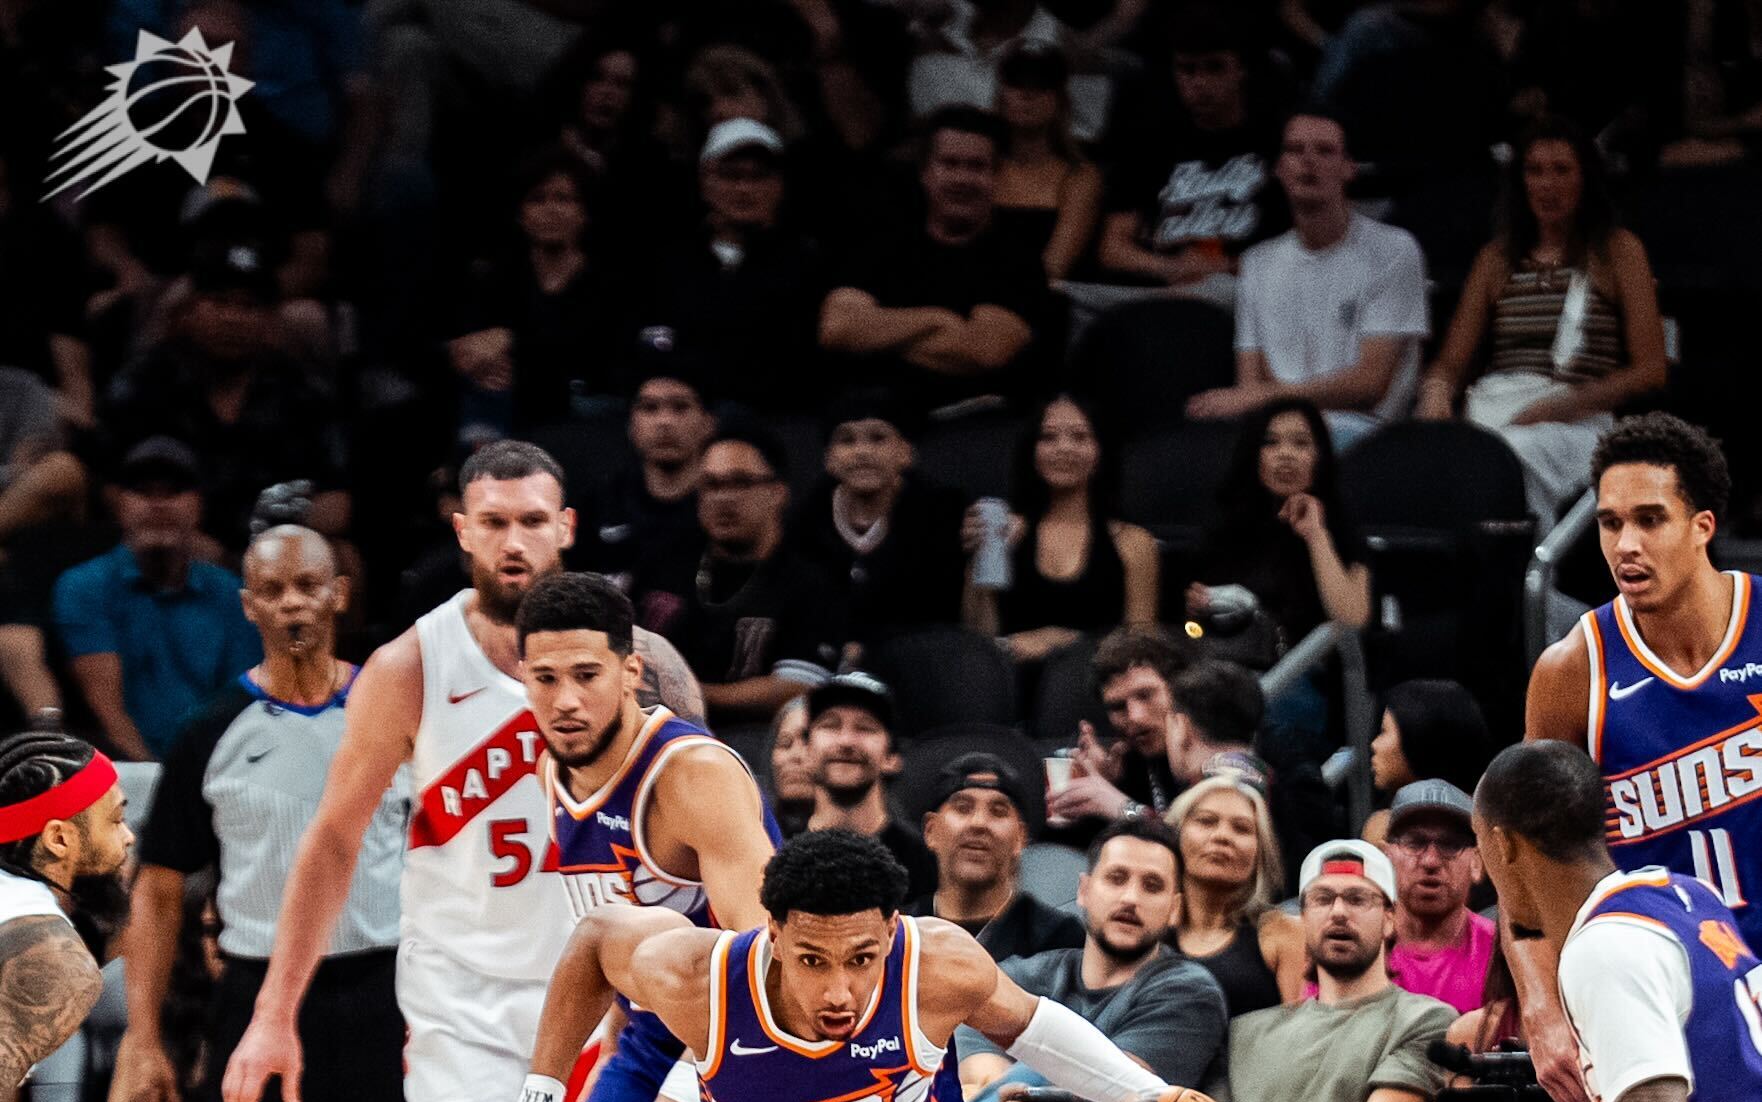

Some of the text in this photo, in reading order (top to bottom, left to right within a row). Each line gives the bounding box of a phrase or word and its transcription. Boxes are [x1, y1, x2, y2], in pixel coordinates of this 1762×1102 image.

[1611, 727, 1762, 839] SUNS
[488, 818, 560, 887] 5
[1688, 828, 1740, 908] 11
[851, 1036, 900, 1059] PayPal
